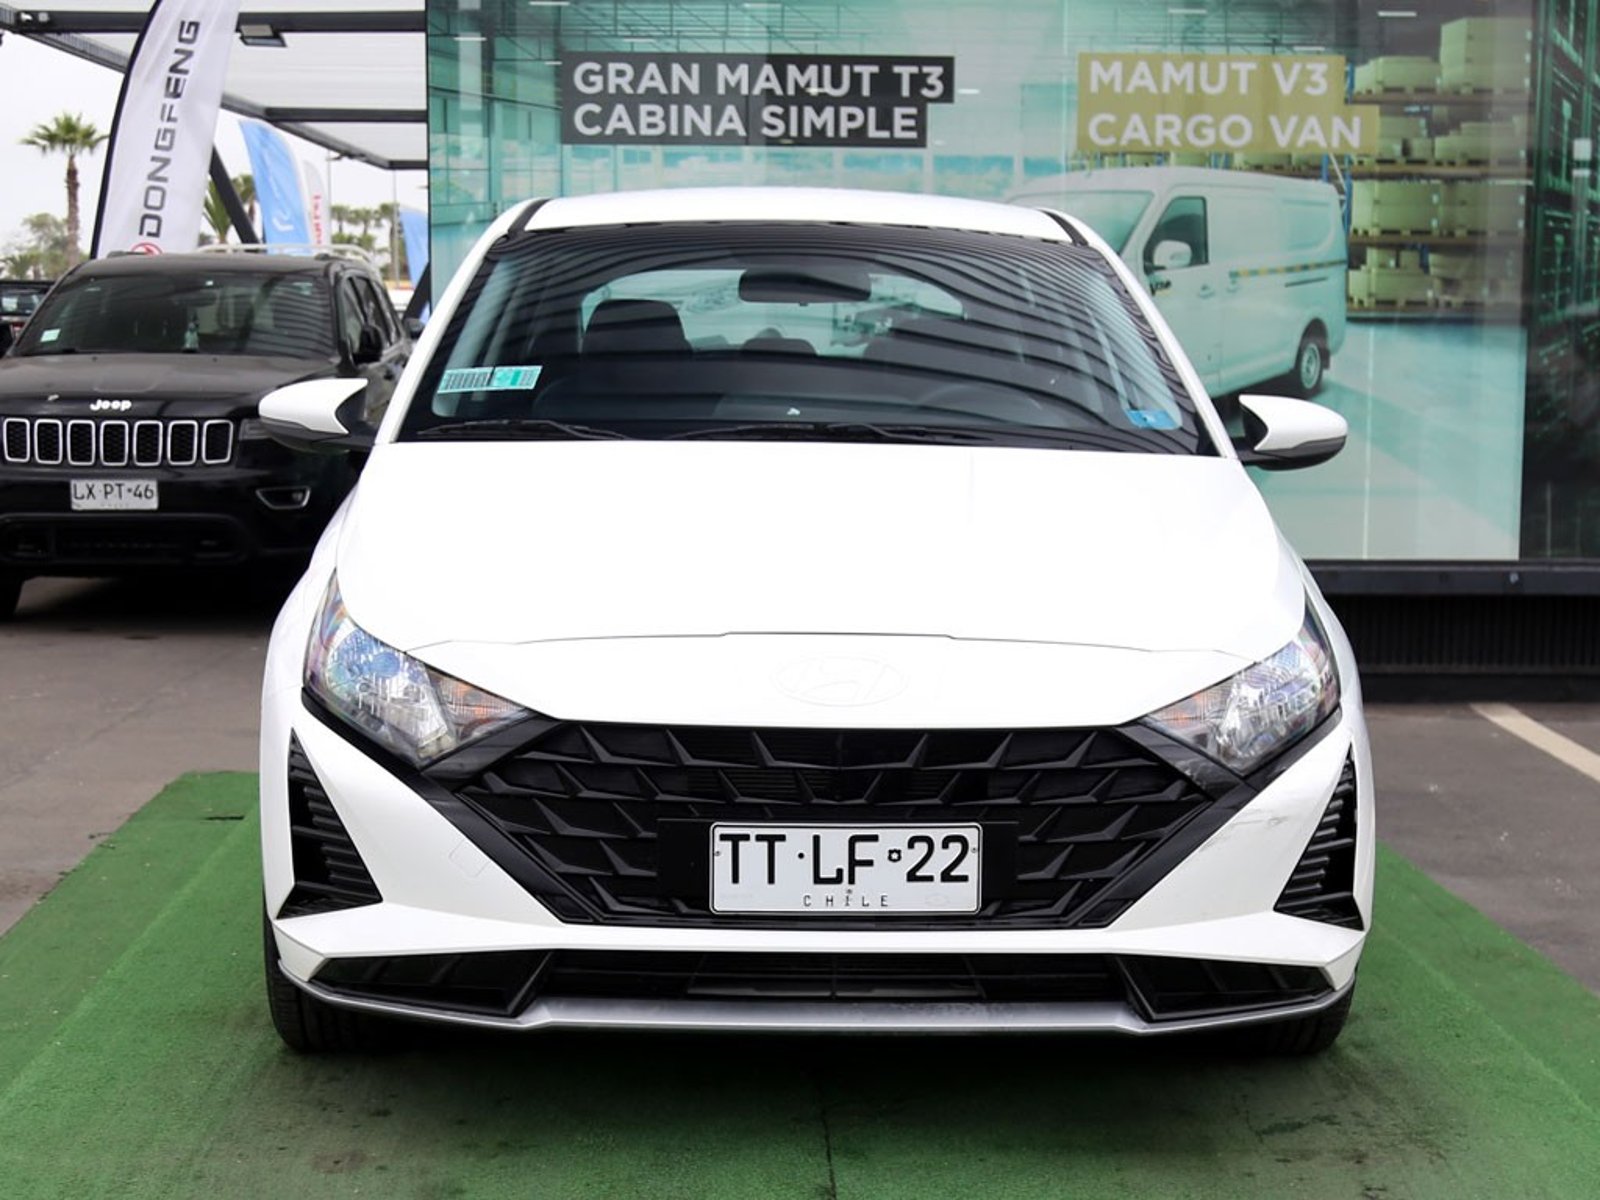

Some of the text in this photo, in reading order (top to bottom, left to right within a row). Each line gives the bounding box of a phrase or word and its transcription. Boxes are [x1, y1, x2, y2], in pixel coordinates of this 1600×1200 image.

[573, 62, 945, 99] GRAN MAMUT T3
[1089, 61, 1328, 96] MAMUT V3
[138, 19, 201, 239] DONGFENG
[573, 104, 919, 139] CABINA SIMPLE
[1087, 114, 1362, 149] CARGO VAN
[89, 399, 133, 412] Jeep
[802, 894, 889, 908] CHILE
